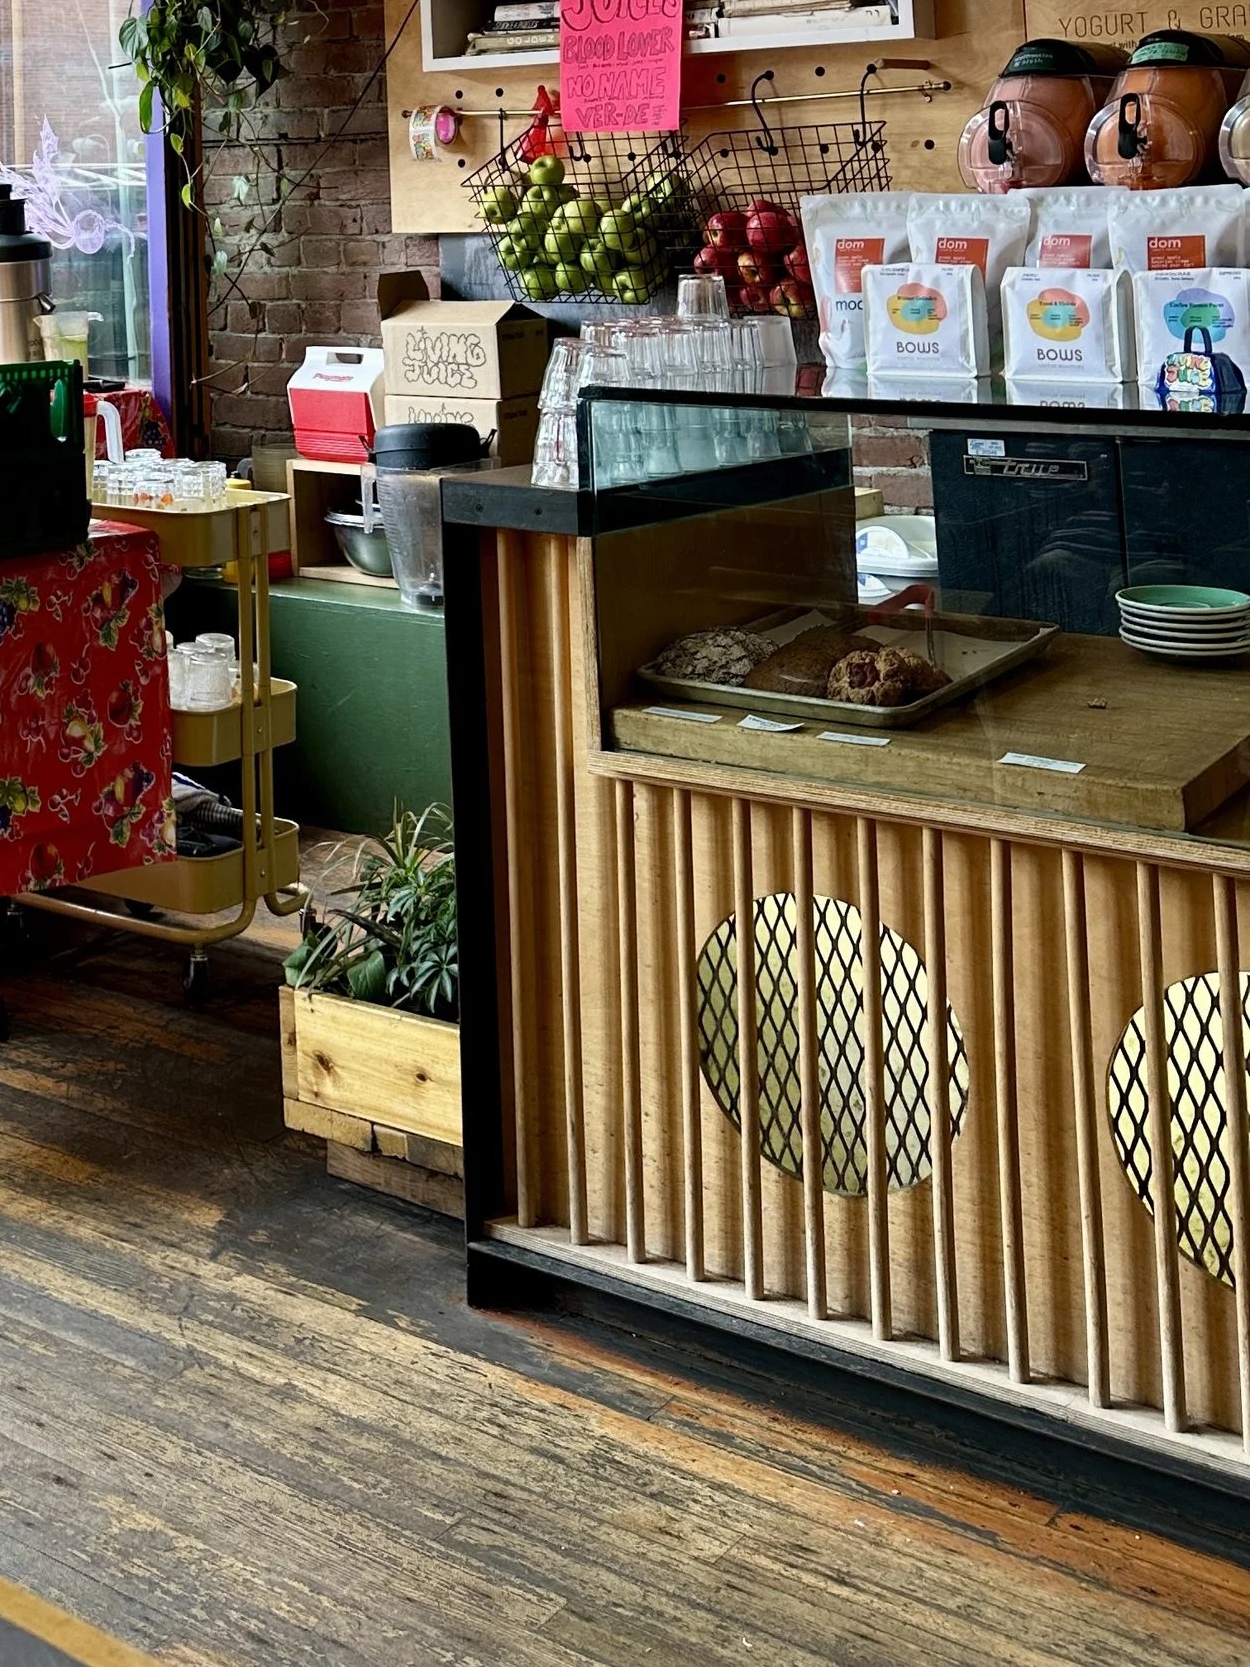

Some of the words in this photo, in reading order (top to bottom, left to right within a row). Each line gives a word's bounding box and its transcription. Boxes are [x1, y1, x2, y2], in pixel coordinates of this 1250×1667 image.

[1058, 11, 1148, 39] YOGURT
[1167, 9, 1181, 30] &
[1200, 4, 1250, 29] GRA
[506, 34, 555, 45] GOLDEN
[563, 33, 616, 65] BLOOD
[617, 26, 675, 61] LOVER
[566, 74, 596, 99] NO
[598, 66, 667, 101] NAME
[575, 102, 651, 128] VER-DE
[837, 239, 865, 249] dom
[938, 237, 968, 249] dom
[1043, 236, 1071, 247] dom
[1149, 237, 1182, 248] dom
[406, 332, 486, 367] LIVING
[896, 341, 940, 354] BOWS
[1037, 348, 1083, 362] BOWS
[402, 356, 477, 389] JUICE
